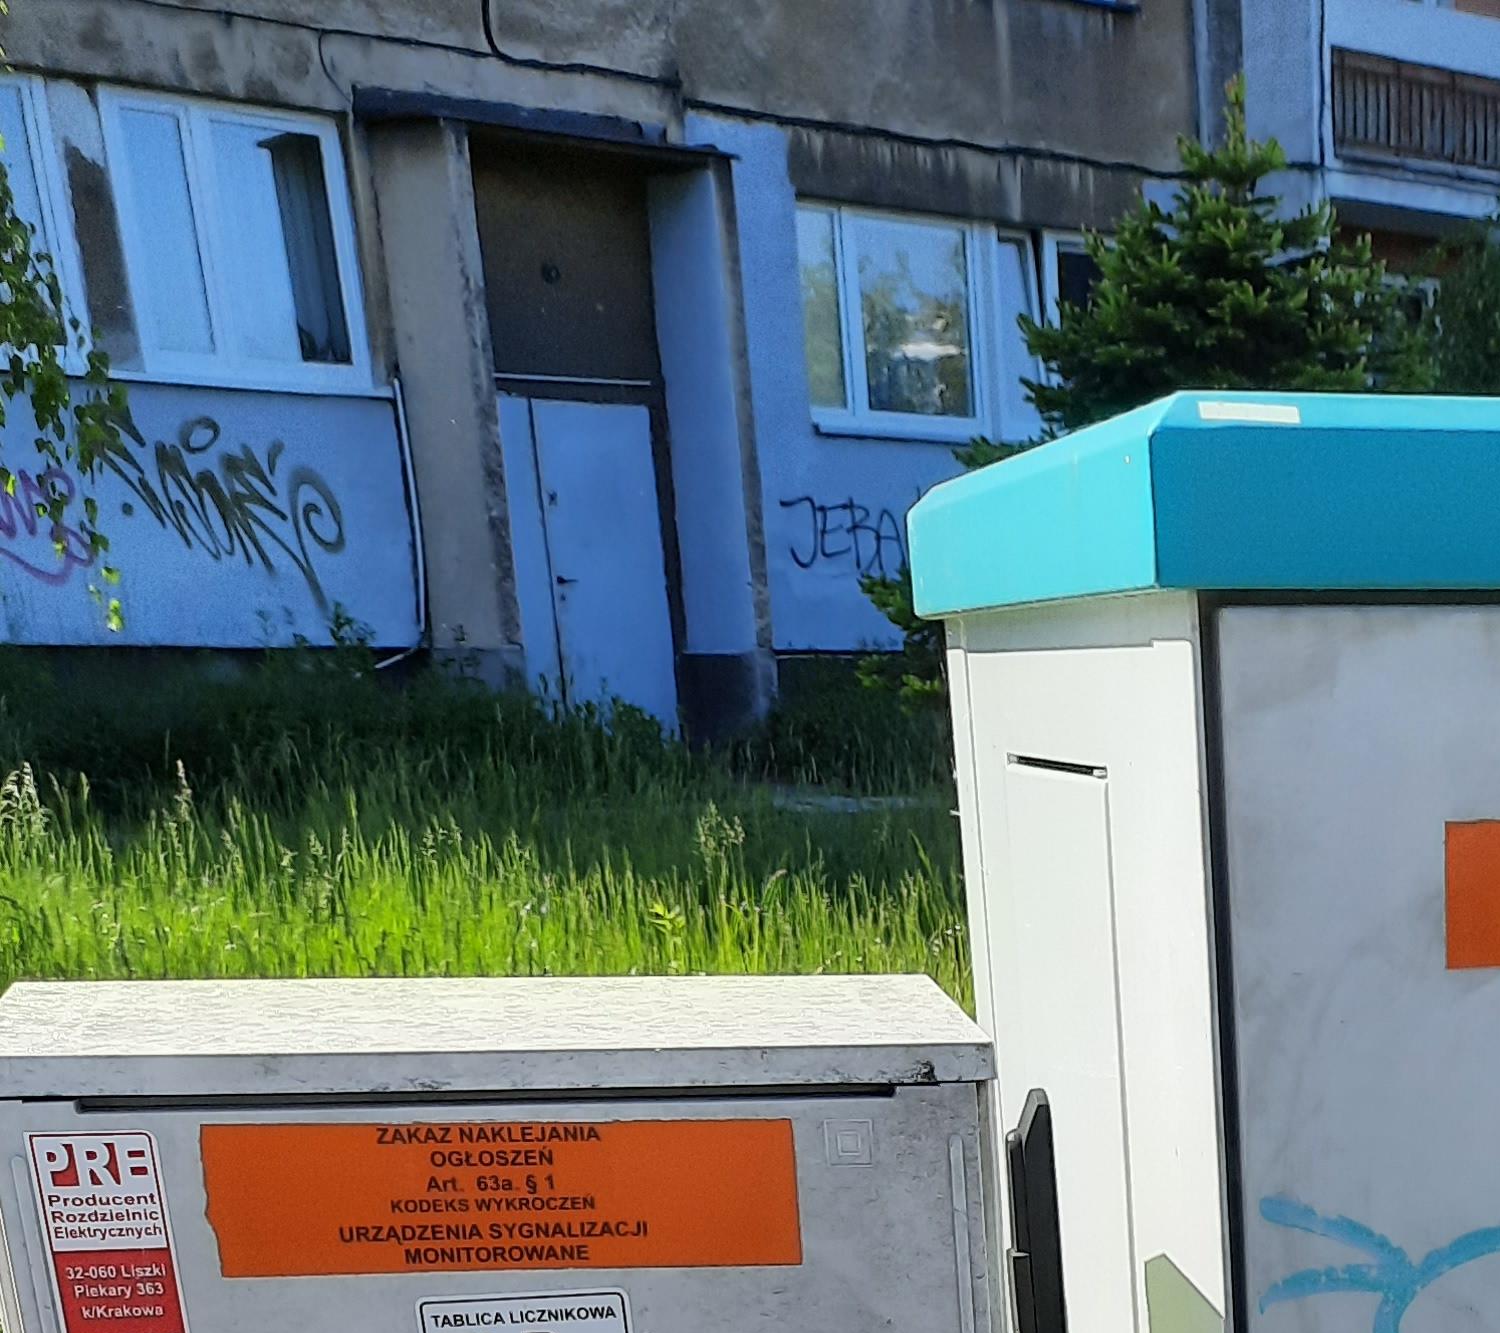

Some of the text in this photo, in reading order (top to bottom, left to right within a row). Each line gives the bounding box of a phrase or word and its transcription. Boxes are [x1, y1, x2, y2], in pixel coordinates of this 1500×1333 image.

[779, 496, 908, 580] JEBA
[376, 1126, 600, 1145] ZAKAZ NAKLEJANIA
[430, 1147, 554, 1167] OGŁOSZEŃ
[426, 1175, 465, 1193] Art.
[545, 1174, 555, 1191] 1
[48, 1192, 157, 1207] Producent
[390, 1194, 596, 1215] KODEKS WYKROCZEŃ
[50, 1209, 160, 1224] Rozdzielnic
[54, 1225, 163, 1241] Elektrycznych
[339, 1220, 649, 1245] URZĄDZENIA SYGNALIZACJI
[405, 1244, 590, 1265] MONITOROWANE
[65, 1263, 167, 1280] 32-060 Liszki
[73, 1282, 164, 1299] Piekary 363
[81, 1304, 164, 1320] k/Krakowa
[431, 1305, 617, 1328] TABLICA LICZNIKOWA
